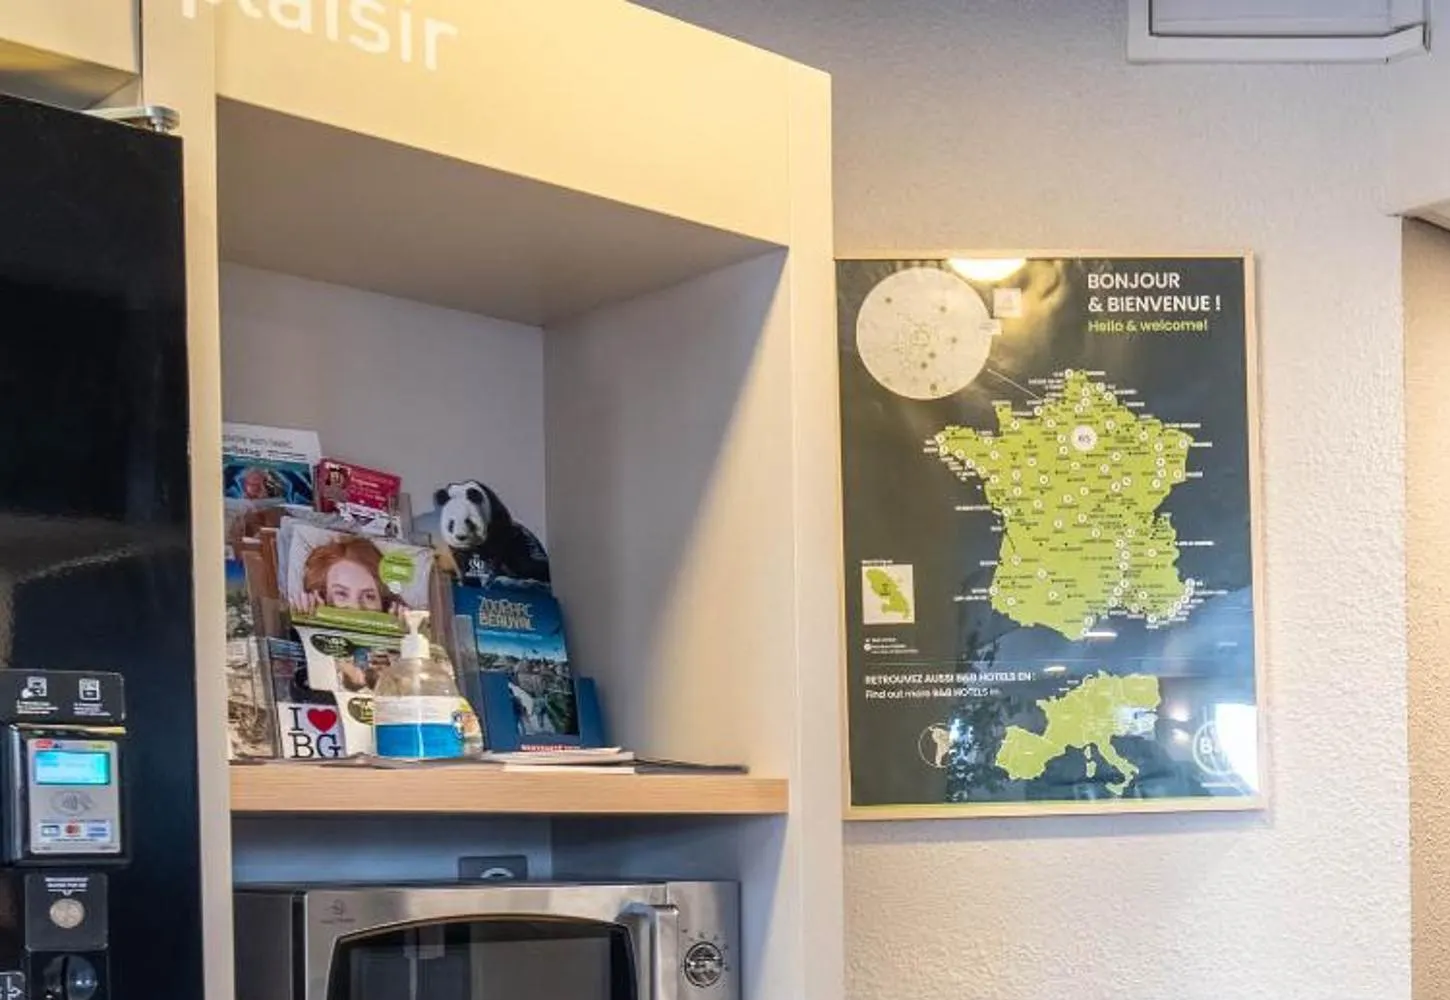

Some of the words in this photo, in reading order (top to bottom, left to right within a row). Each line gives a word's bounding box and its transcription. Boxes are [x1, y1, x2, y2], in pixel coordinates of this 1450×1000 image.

[182, 0, 459, 71] aisir
[1087, 272, 1181, 289] BONJOUR
[1087, 296, 1104, 313] &
[1107, 294, 1211, 312] BIENVENUE
[1215, 294, 1221, 311] !
[1087, 319, 1124, 333] Hello
[1126, 319, 1137, 333] &
[1140, 317, 1208, 333] welcome!
[288, 733, 342, 758] BG
